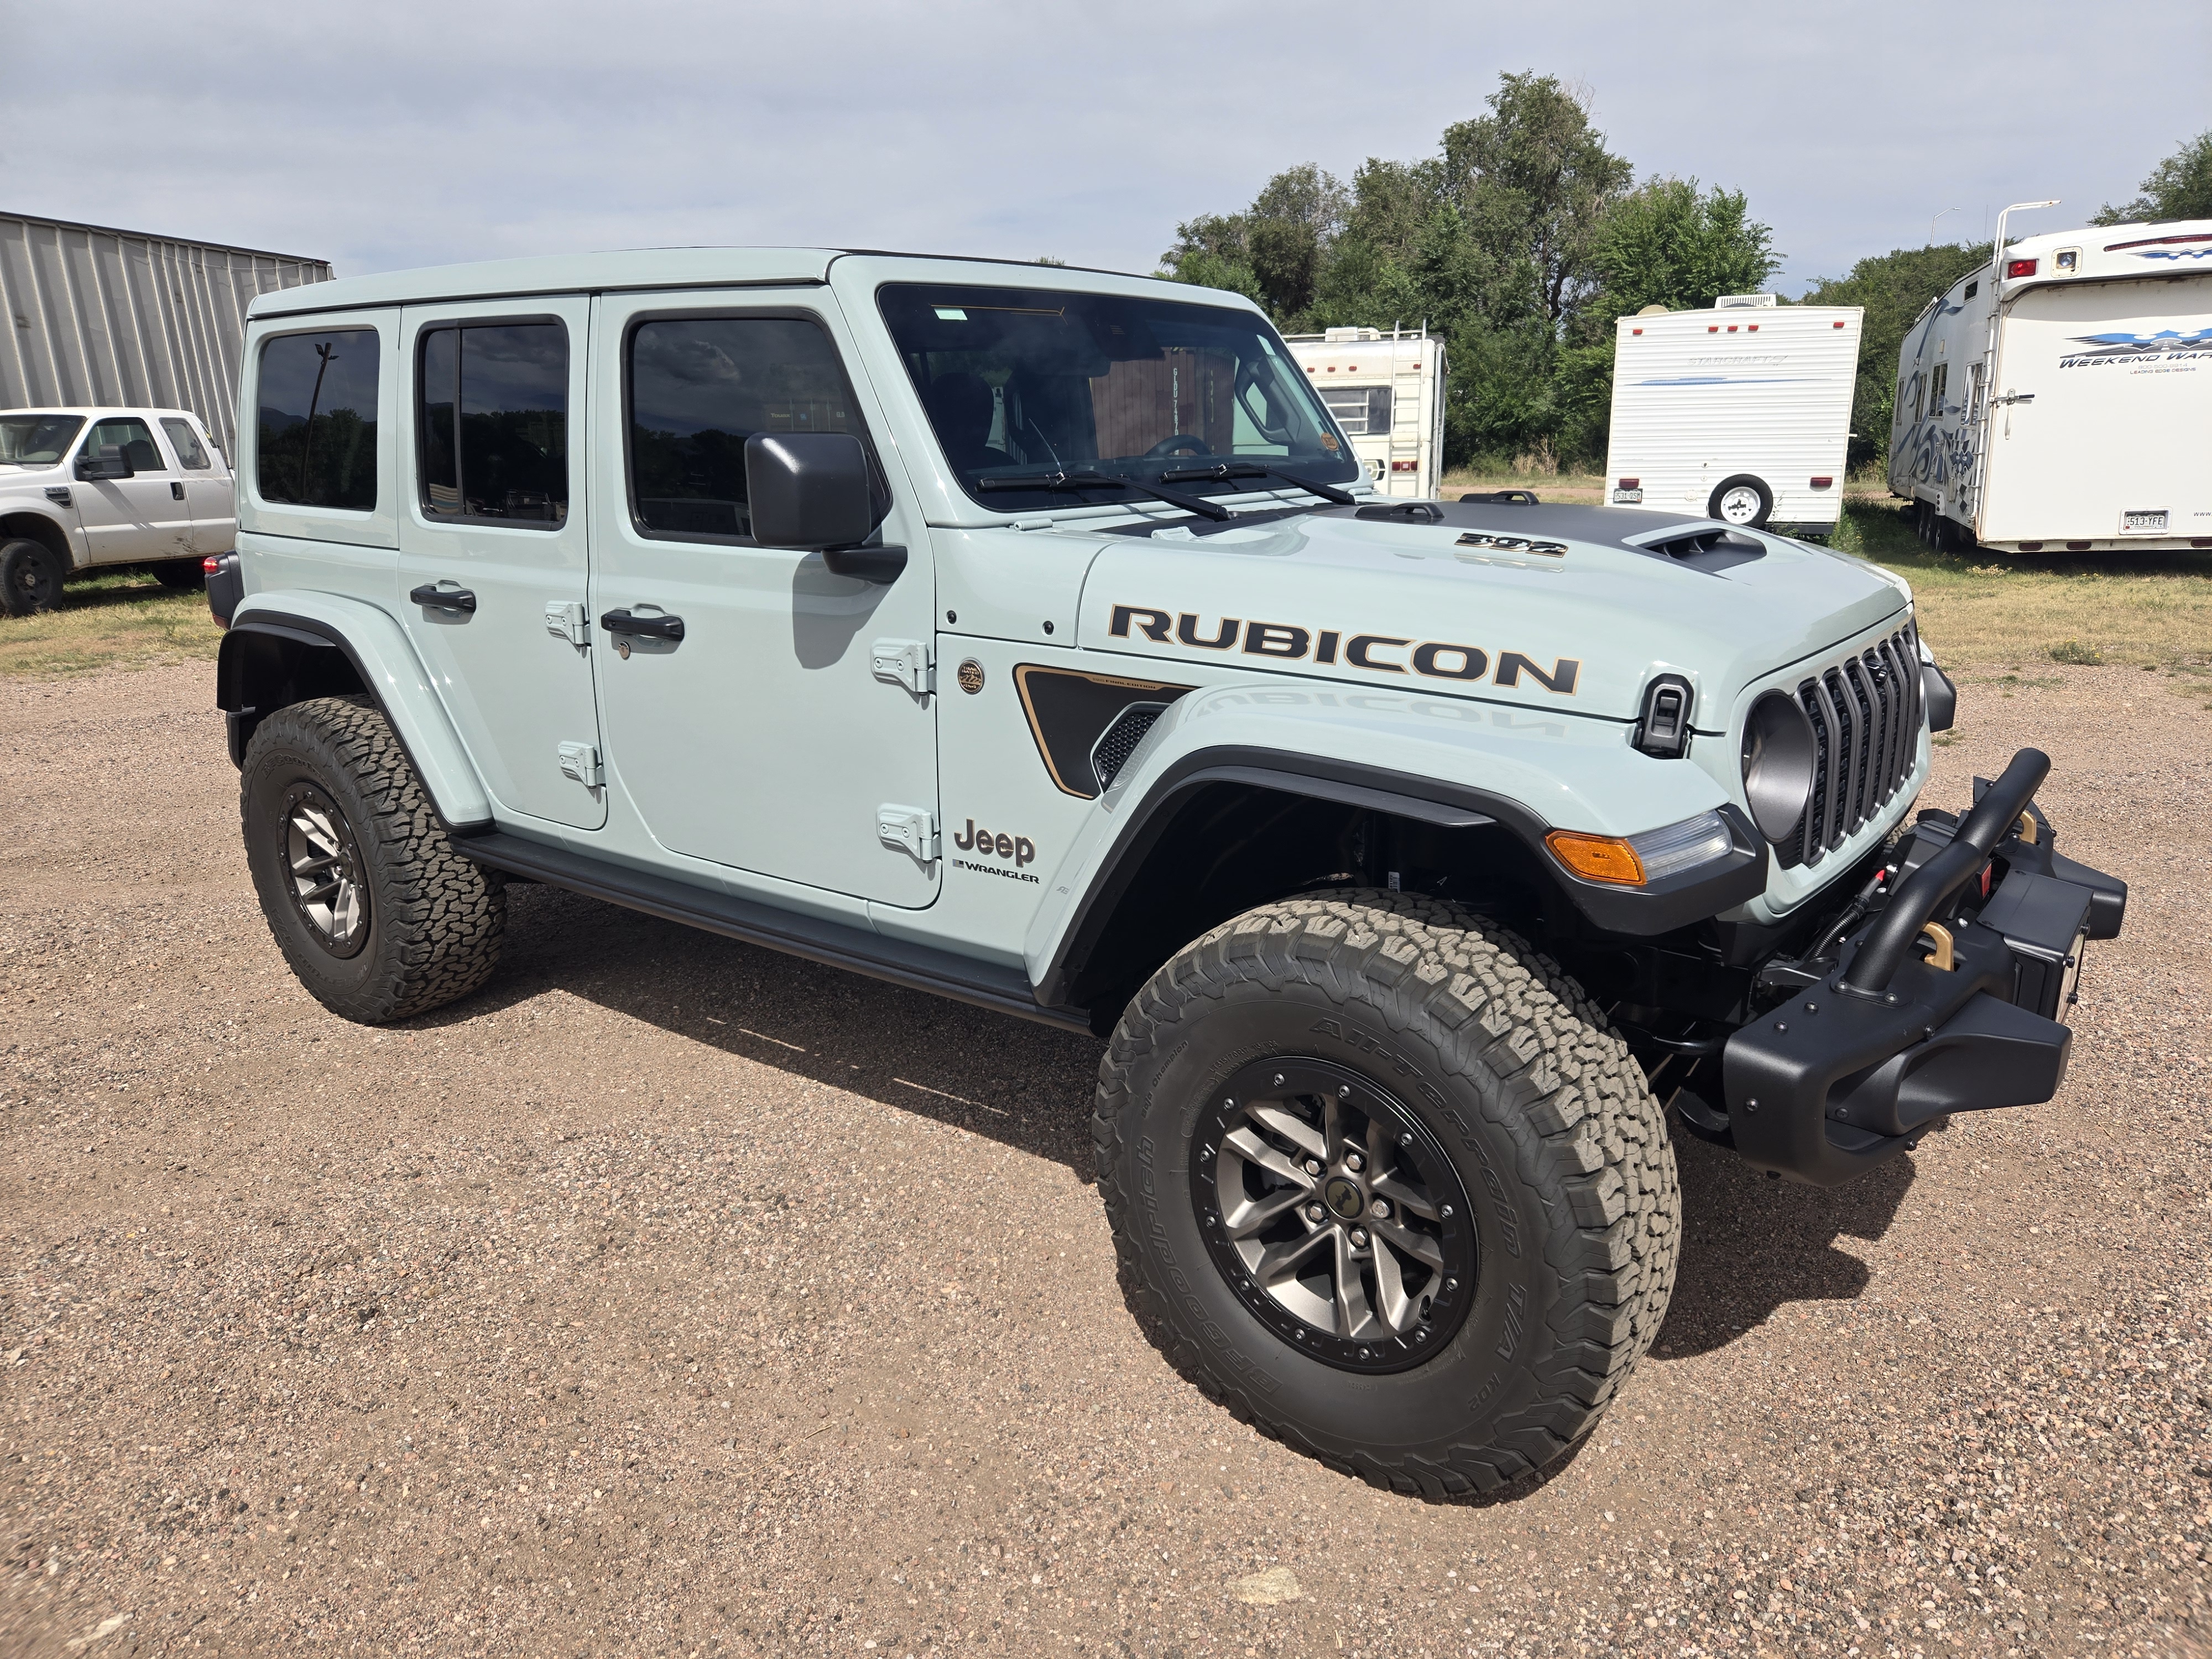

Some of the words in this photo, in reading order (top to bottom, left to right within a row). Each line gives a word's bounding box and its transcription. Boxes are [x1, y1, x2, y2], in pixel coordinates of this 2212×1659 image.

[1687, 356, 1771, 366] STARCRAFT
[2059, 354, 2161, 369] WEEKEND
[1454, 533, 1569, 558] 392
[1108, 603, 1583, 696] RUBICON
[954, 818, 1036, 868] Jeep
[964, 861, 1040, 884] WRANGLER
[1309, 1017, 1521, 1259] All-Terrain
[1137, 1135, 1284, 1395] BFGoodrich
